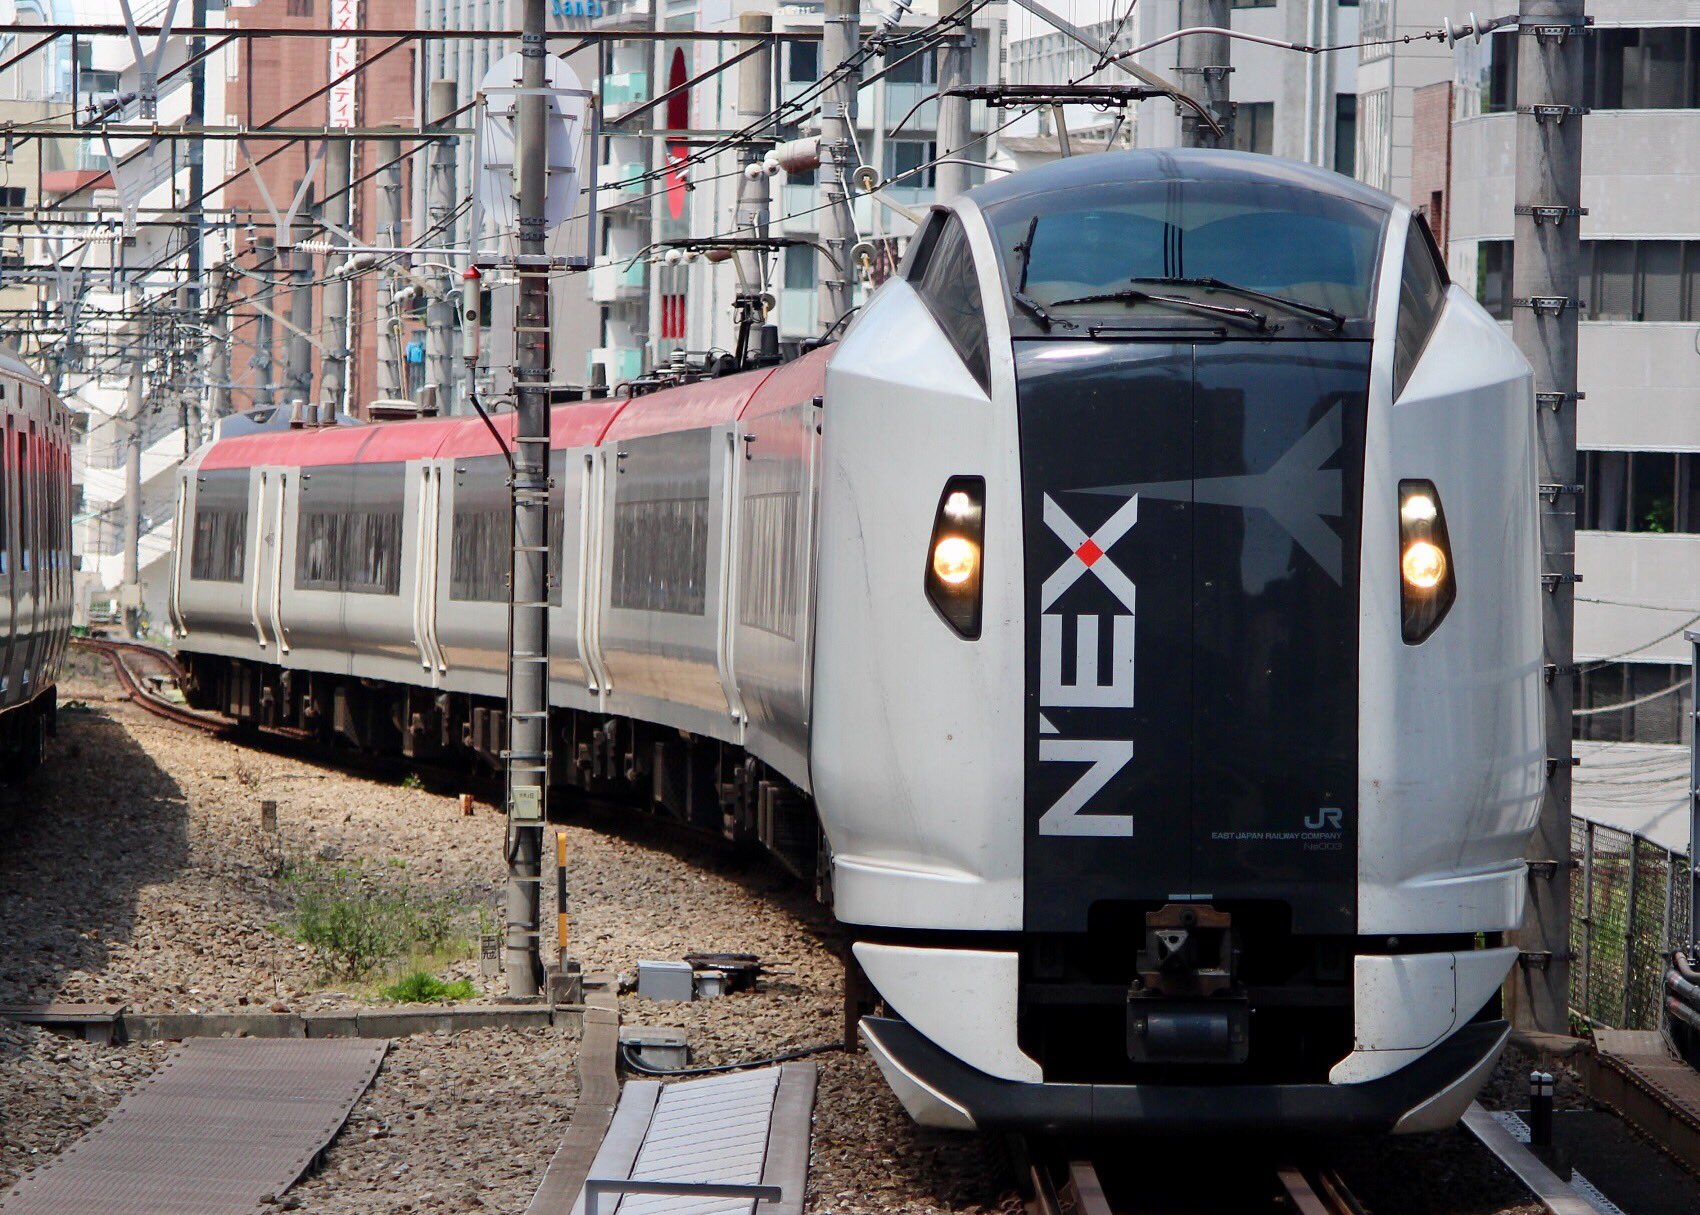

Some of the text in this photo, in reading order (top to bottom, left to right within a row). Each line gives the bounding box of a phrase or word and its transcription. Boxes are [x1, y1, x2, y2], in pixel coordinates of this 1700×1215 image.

[1039, 491, 1138, 837] N'EX
[1304, 807, 1343, 829] JR
[1211, 832, 1342, 840] EAST JAPAN RAILWAY COMPANY
